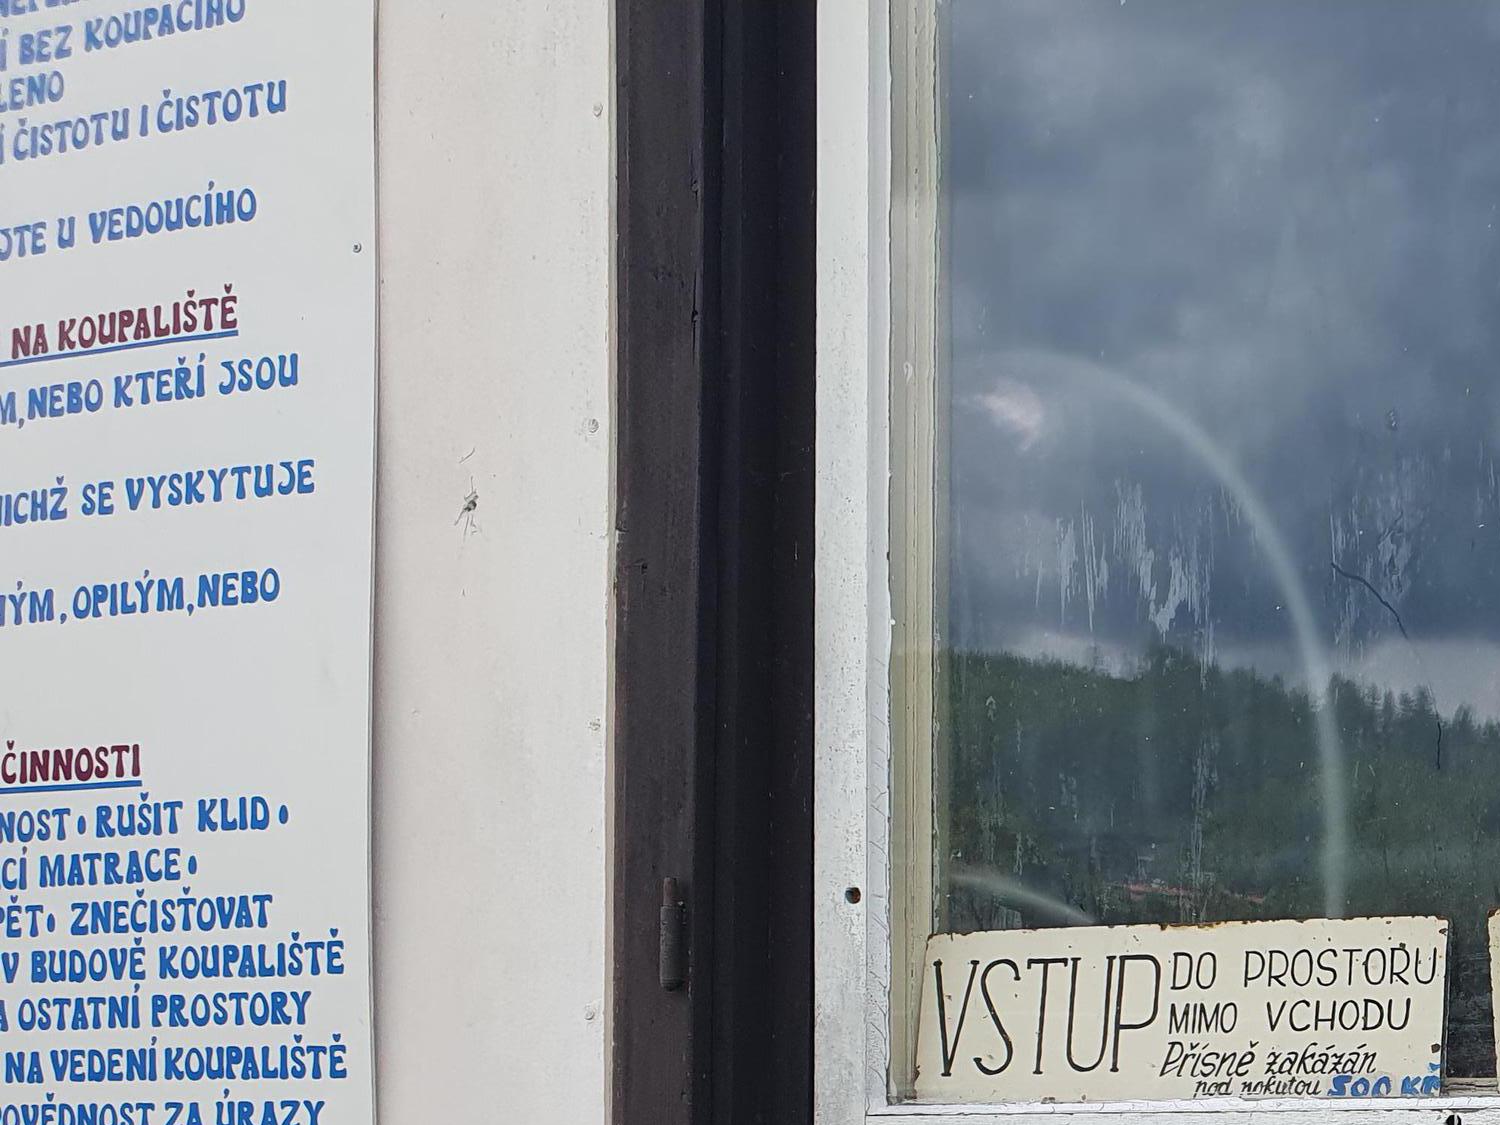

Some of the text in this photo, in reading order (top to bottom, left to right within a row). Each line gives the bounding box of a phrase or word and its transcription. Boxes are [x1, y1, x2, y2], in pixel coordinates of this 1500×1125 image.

[18, 25, 73, 65] BEZ
[13, 107, 130, 161] ČISTOTU
[139, 104, 149, 137] I
[156, 79, 287, 133] ČISTOTU
[57, 216, 76, 249] U
[88, 180, 258, 244] VEDOUCÍHO
[11, 283, 238, 360] NA KOUPALIŠTĚ
[113, 352, 206, 408] KTEŘÍ
[218, 353, 299, 395] JSOU
[0, 459, 315, 527] ICHŽ SE VYSKYTUJE
[196, 568, 280, 608] NEBO
[1, 740, 141, 785] ČINNOSTI
[95, 792, 184, 838] RUŠIT
[0, 846, 28, 891] CÍ
[1, 928, 346, 984] V BUDOVĚ KOUPALIŠTĚ
[18, 983, 141, 1031] OSTATNÍ
[151, 990, 312, 1028] PROSTORY
[932, 946, 1438, 1078] VSTUP DO PROSTORU
[1168, 997, 1412, 1035] MIMO VCHODU
[5, 1033, 348, 1084] NA VEDENÍ KOUPALIŠTĚ
[1265, 1042, 1378, 1076] zakázán
[1327, 1074, 1393, 1097] 500
